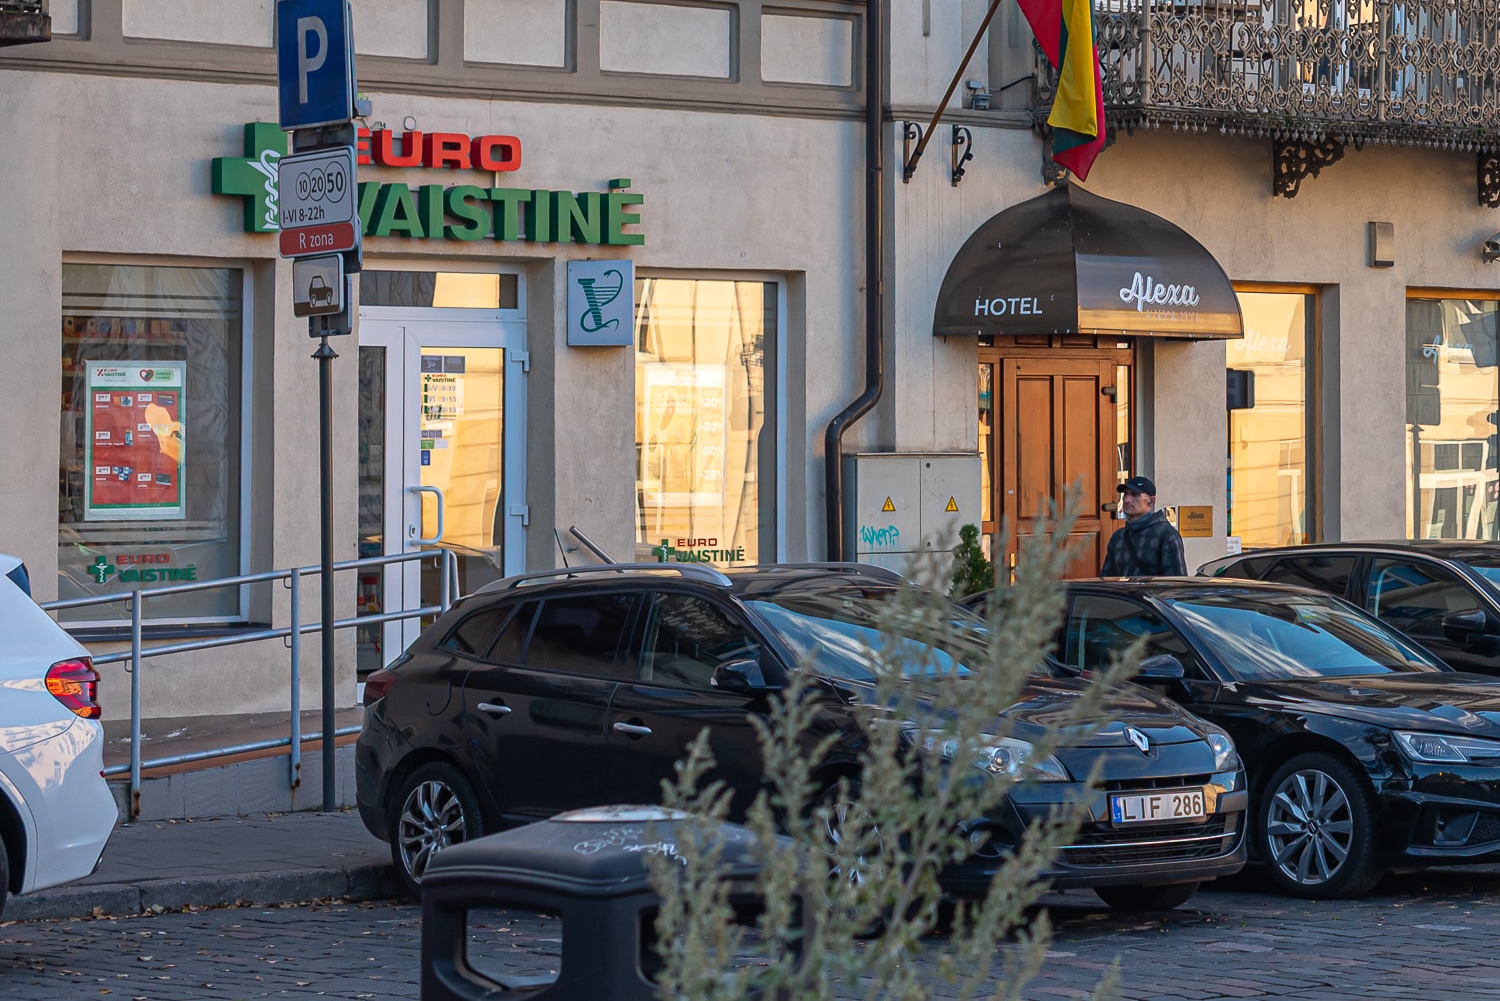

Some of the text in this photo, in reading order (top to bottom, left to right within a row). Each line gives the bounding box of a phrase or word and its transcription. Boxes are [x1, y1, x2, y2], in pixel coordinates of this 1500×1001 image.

[297, 16, 329, 105] P
[299, 171, 344, 194] 10 20 50
[282, 204, 325, 225] I-VI 8-22h
[299, 232, 334, 249] R zona
[1119, 271, 1200, 314] Alexa
[974, 297, 1043, 316] HOTEL
[677, 537, 719, 547] EURO
[116, 554, 171, 565] EURO
[675, 545, 746, 563] VAISTINĖ
[119, 564, 198, 582] VAISTINĖ
[1123, 794, 1201, 820] LIF 286
